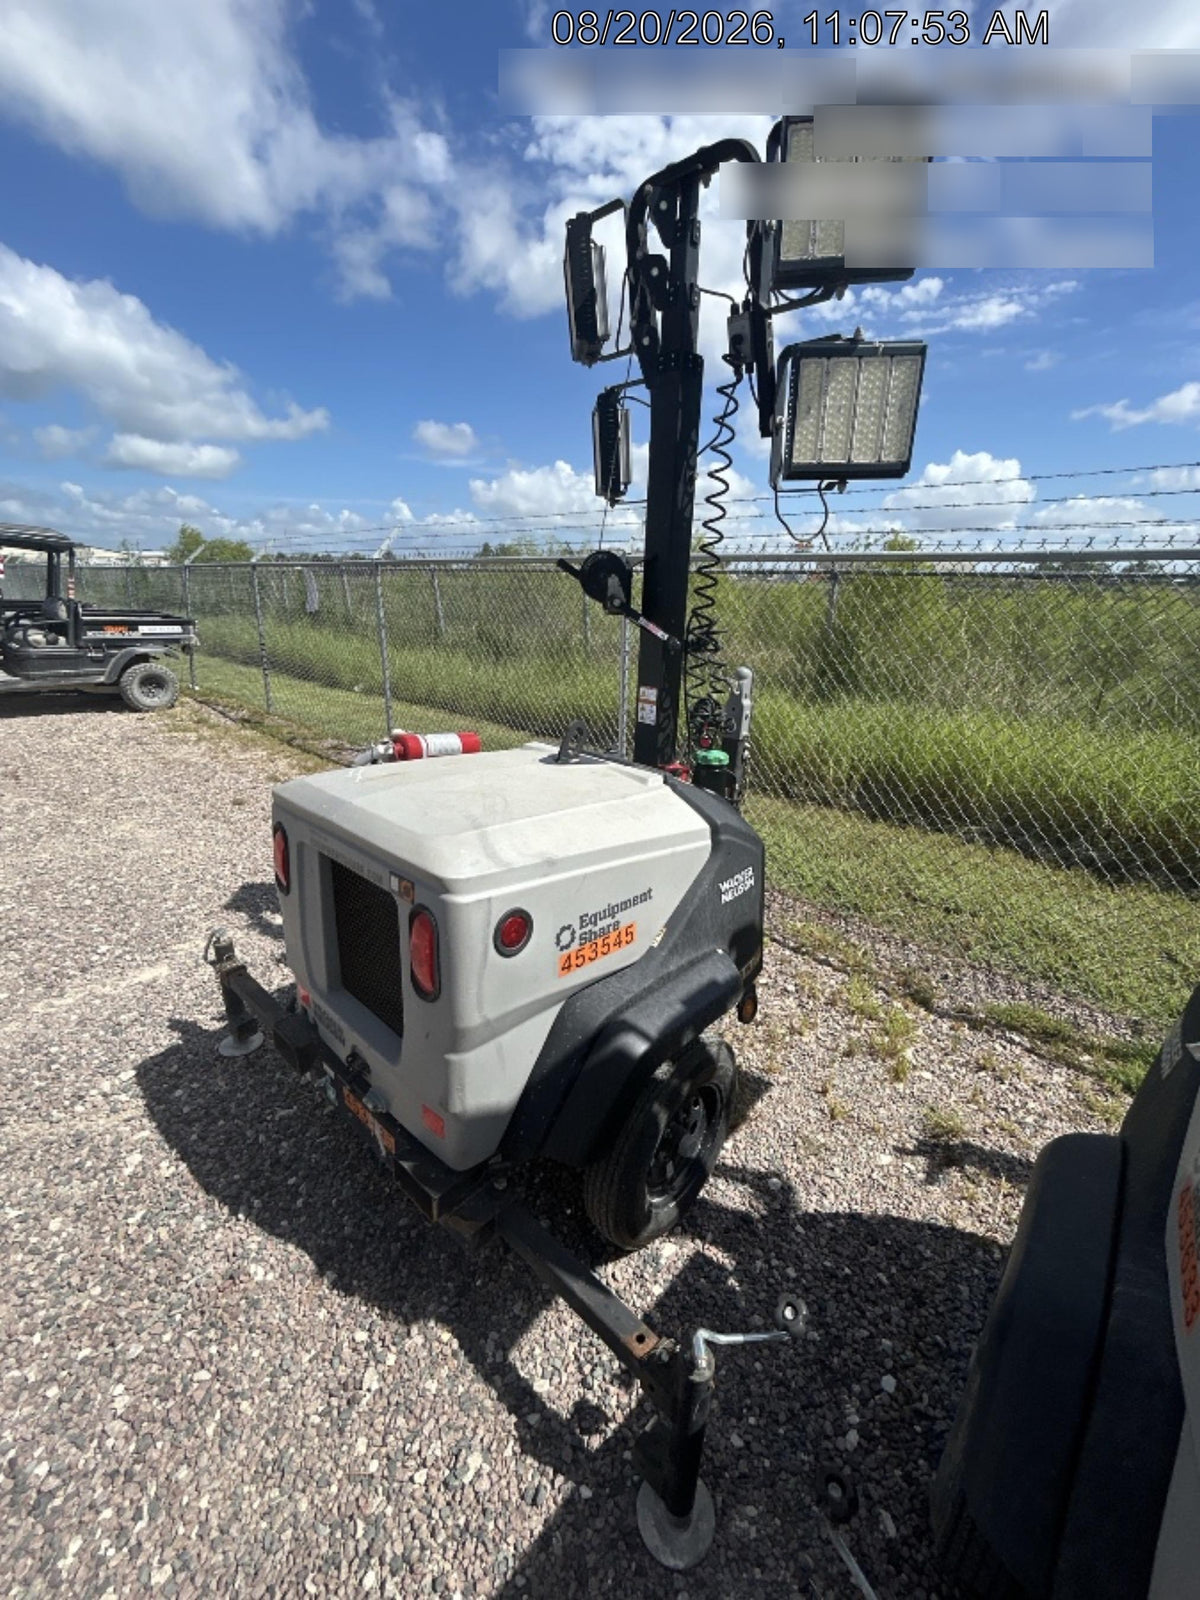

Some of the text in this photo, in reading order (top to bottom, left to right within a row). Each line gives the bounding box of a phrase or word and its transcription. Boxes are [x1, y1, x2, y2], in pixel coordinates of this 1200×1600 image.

[721, 875, 754, 904] NEUSON
[579, 887, 653, 930] Equipment
[561, 923, 634, 972] 453545
[579, 920, 620, 946] Share
